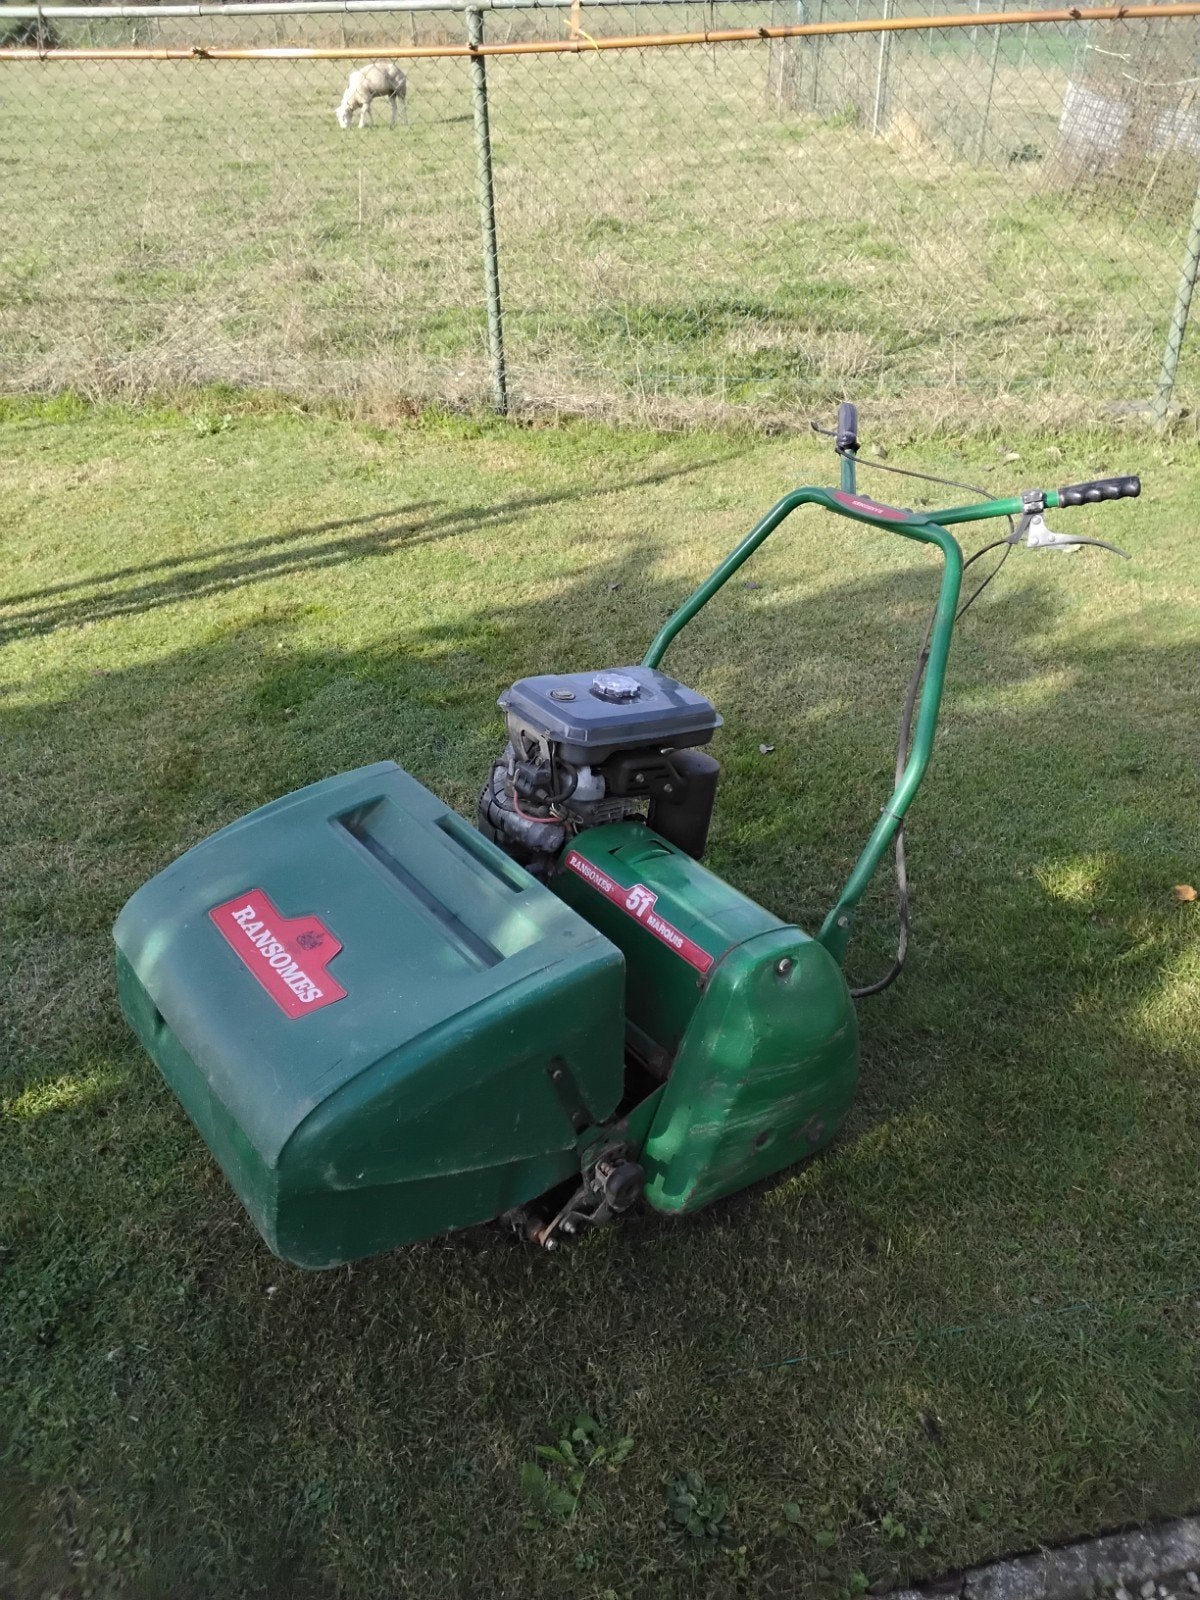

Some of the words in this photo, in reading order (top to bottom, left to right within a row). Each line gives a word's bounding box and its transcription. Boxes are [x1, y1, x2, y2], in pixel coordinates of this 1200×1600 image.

[569, 856, 612, 892] RANSOMES
[625, 887, 654, 917] 51
[647, 916, 684, 948] MARQUIS
[231, 905, 324, 1002] RANSOMES
